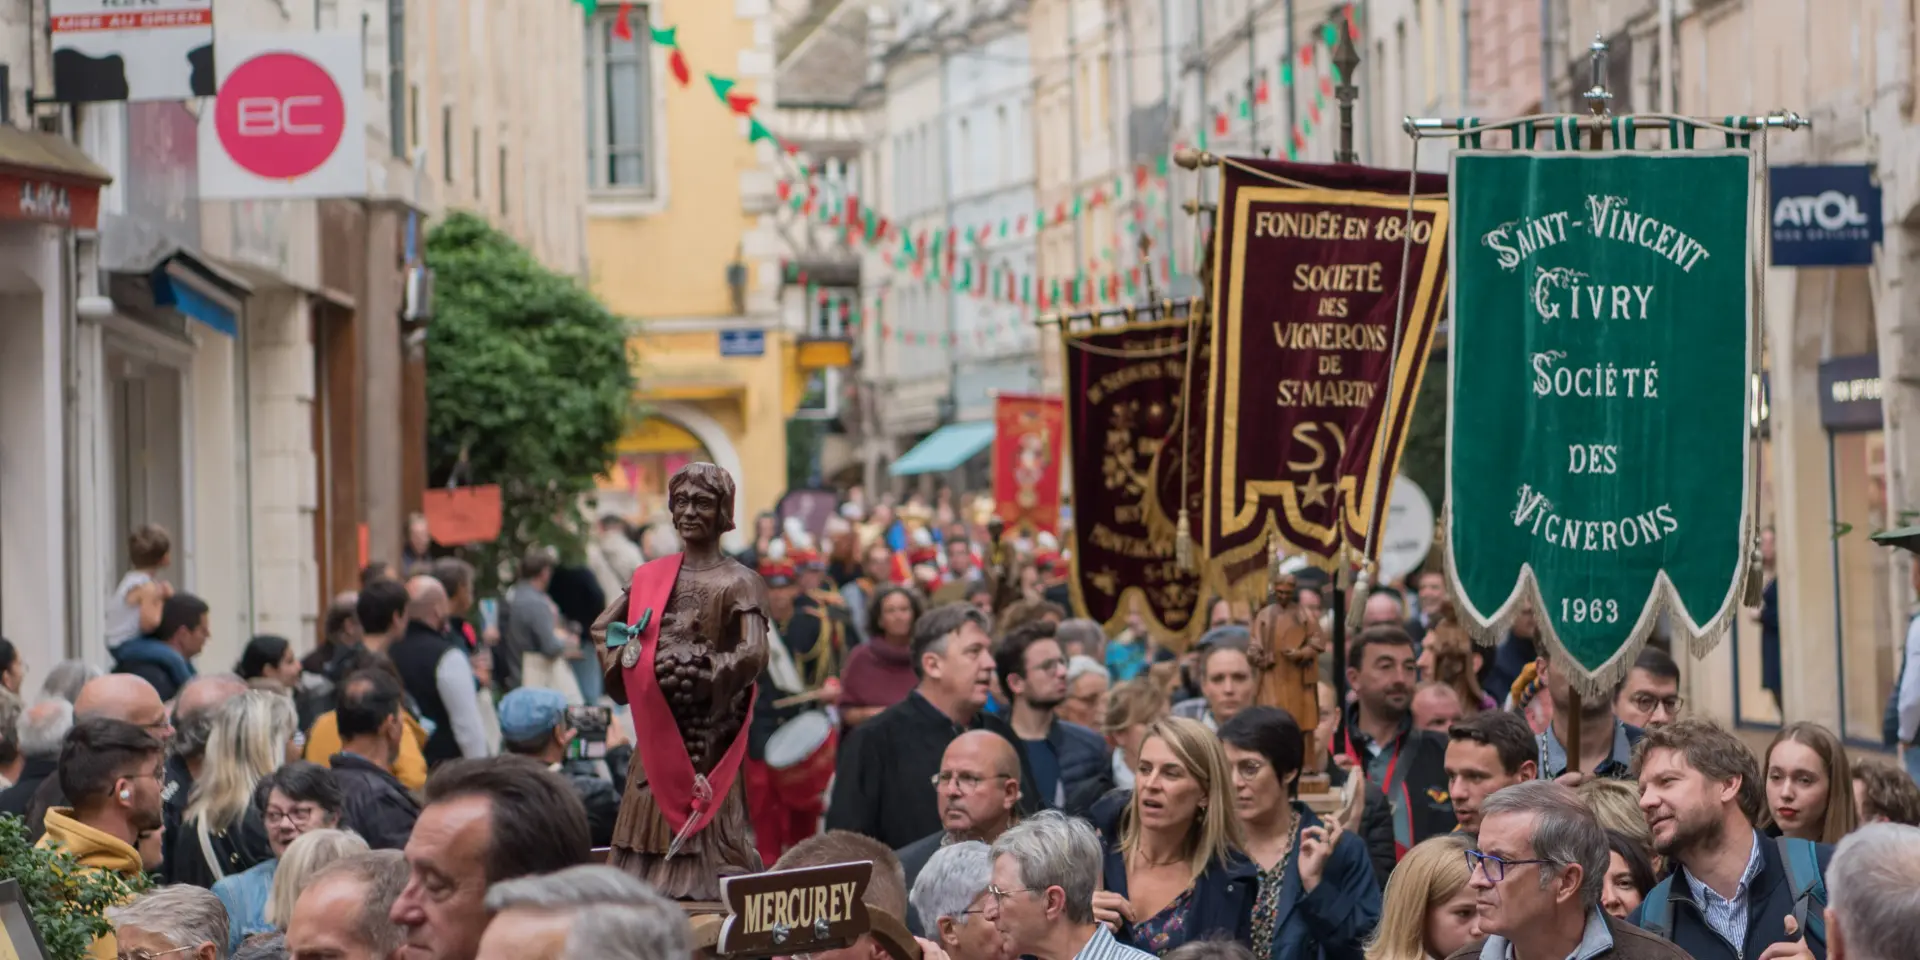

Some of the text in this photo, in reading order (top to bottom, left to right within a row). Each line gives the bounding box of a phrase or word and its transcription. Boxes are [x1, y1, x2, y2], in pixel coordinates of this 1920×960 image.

[57, 10, 203, 31] MISE AU GREEN
[238, 96, 323, 136] BC
[1255, 210, 1341, 240] FONDÉE
[1343, 217, 1369, 240] EN
[1774, 191, 1868, 230] ATOL
[1317, 297, 1348, 318] DES
[1273, 321, 1388, 351] VIGNERONS
[1318, 355, 1342, 375] DE
[1301, 380, 1377, 408] MARTIN
[1568, 444, 1617, 474] DES
[1510, 483, 1678, 551] VIGNERONS
[1561, 598, 1619, 623] 1963
[743, 881, 857, 935] MERCUREY
